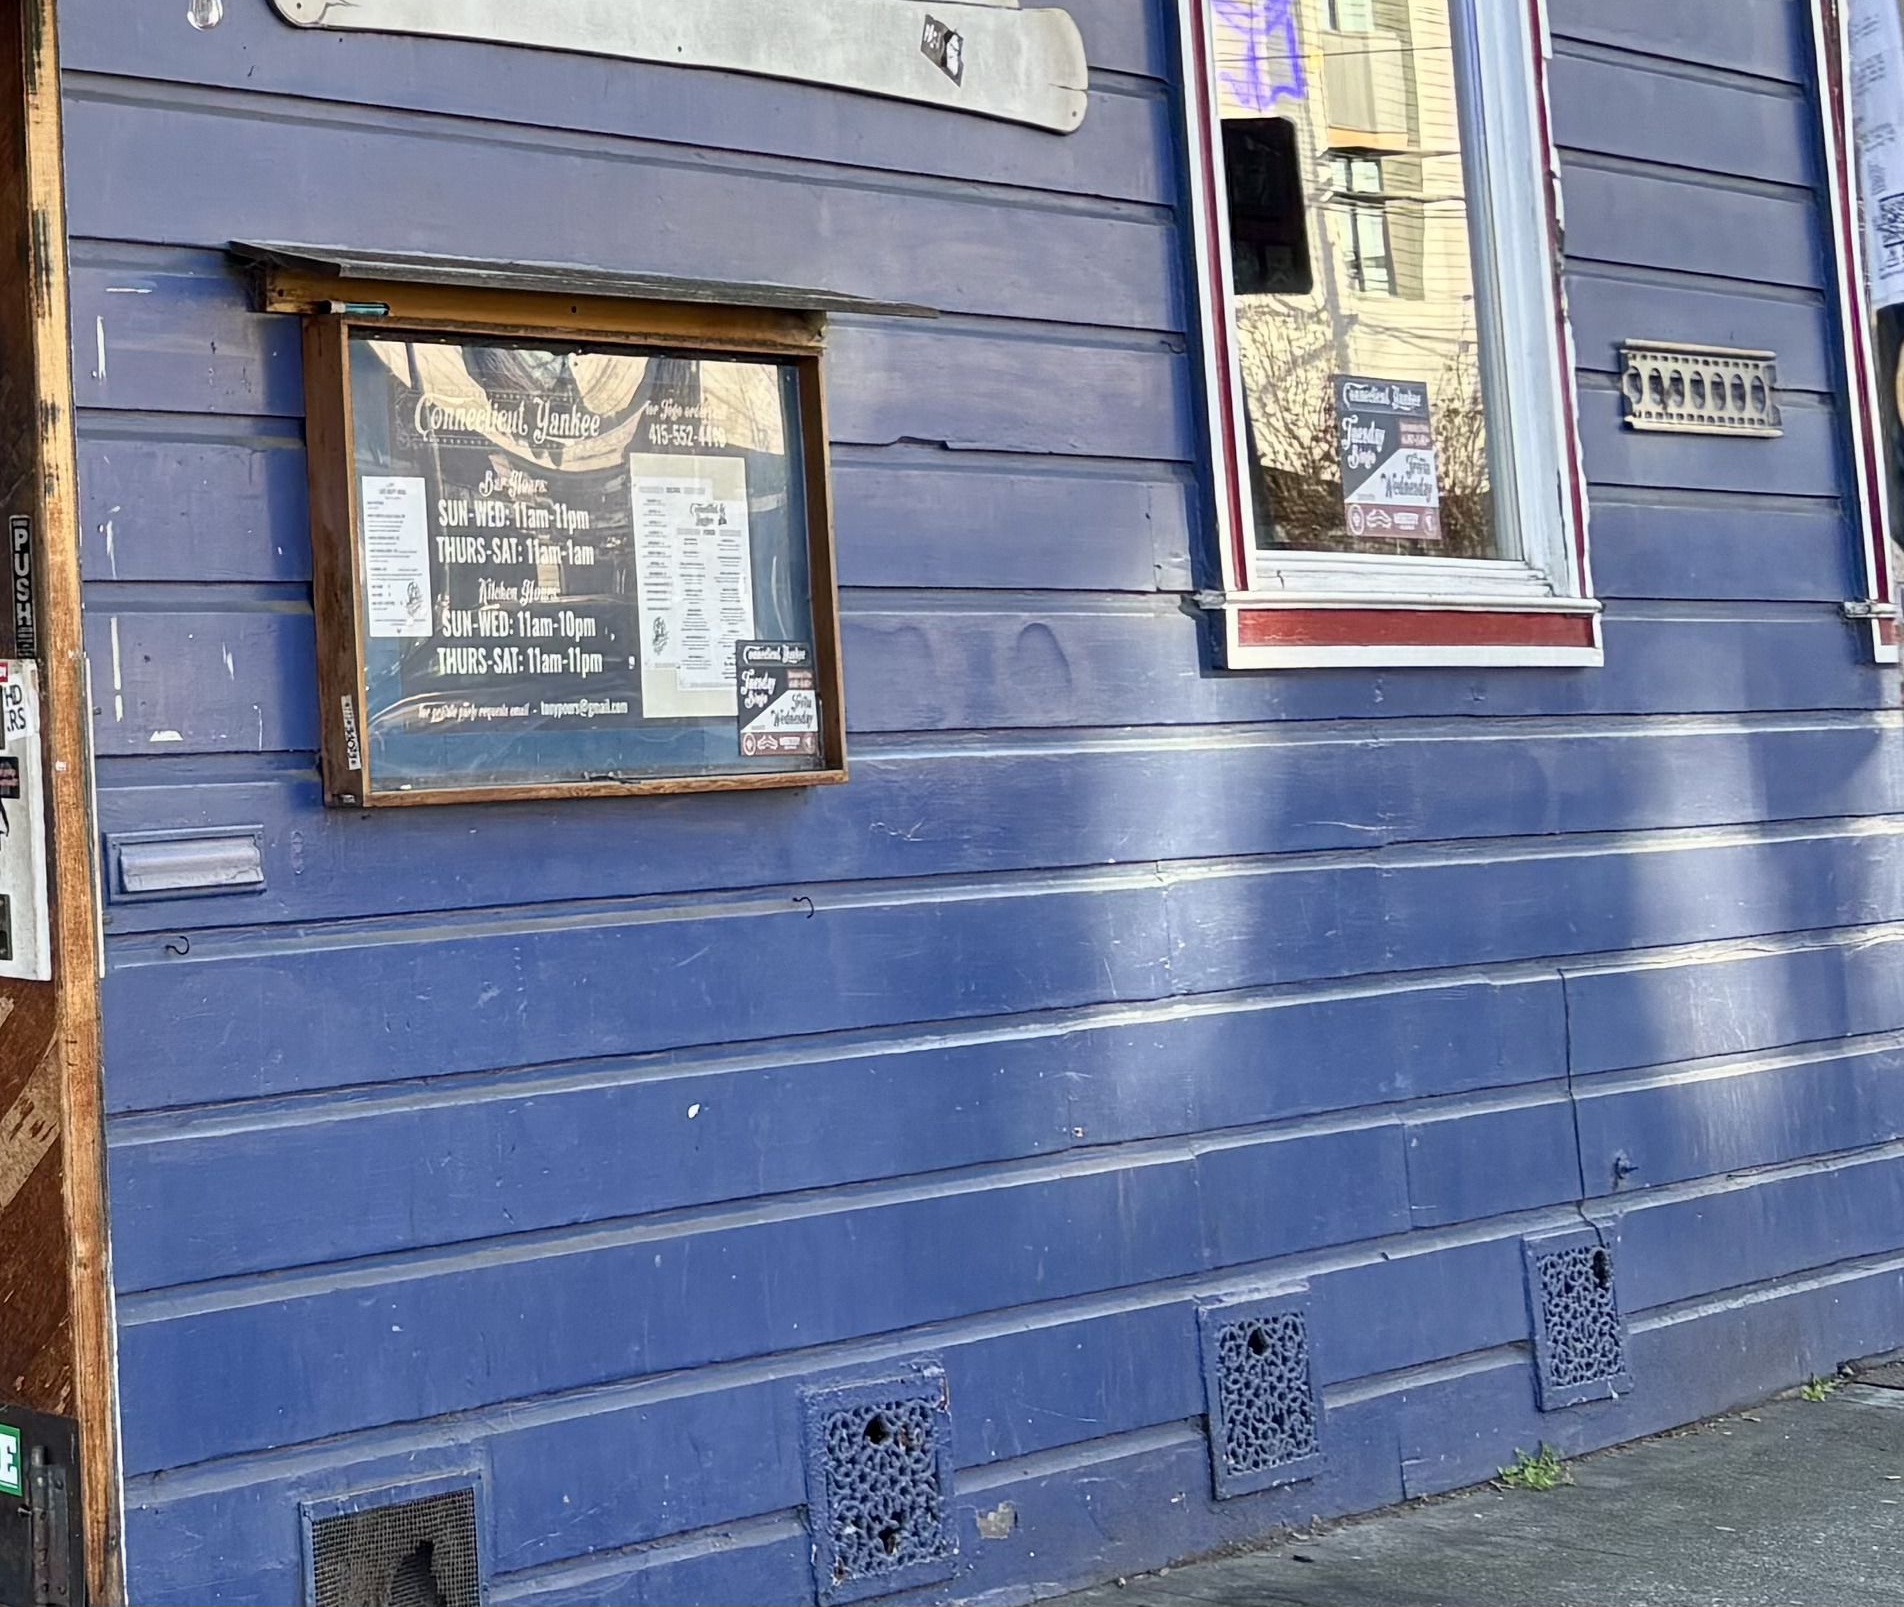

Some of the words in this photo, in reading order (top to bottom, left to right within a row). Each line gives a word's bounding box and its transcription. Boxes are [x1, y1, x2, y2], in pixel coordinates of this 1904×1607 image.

[414, 394, 529, 442] Connecticut
[533, 397, 601, 444] Yankee
[1341, 414, 1386, 453] Tuesday
[1380, 472, 1433, 503] Wednesday
[438, 498, 510, 528] SUN-WED:
[514, 501, 590, 534] 11am-11pm
[436, 535, 523, 565] THURS-SAT:
[527, 537, 594, 566] 11am-1am
[12, 528, 34, 626] PUSH
[442, 609, 514, 639] SUN-WED:
[517, 610, 596, 643] 11am-10pm
[437, 646, 525, 676] THURS-SAT:
[527, 646, 603, 679] 11am-11pm
[740, 668, 776, 695] Tuesday
[769, 707, 815, 728] Wednesday
